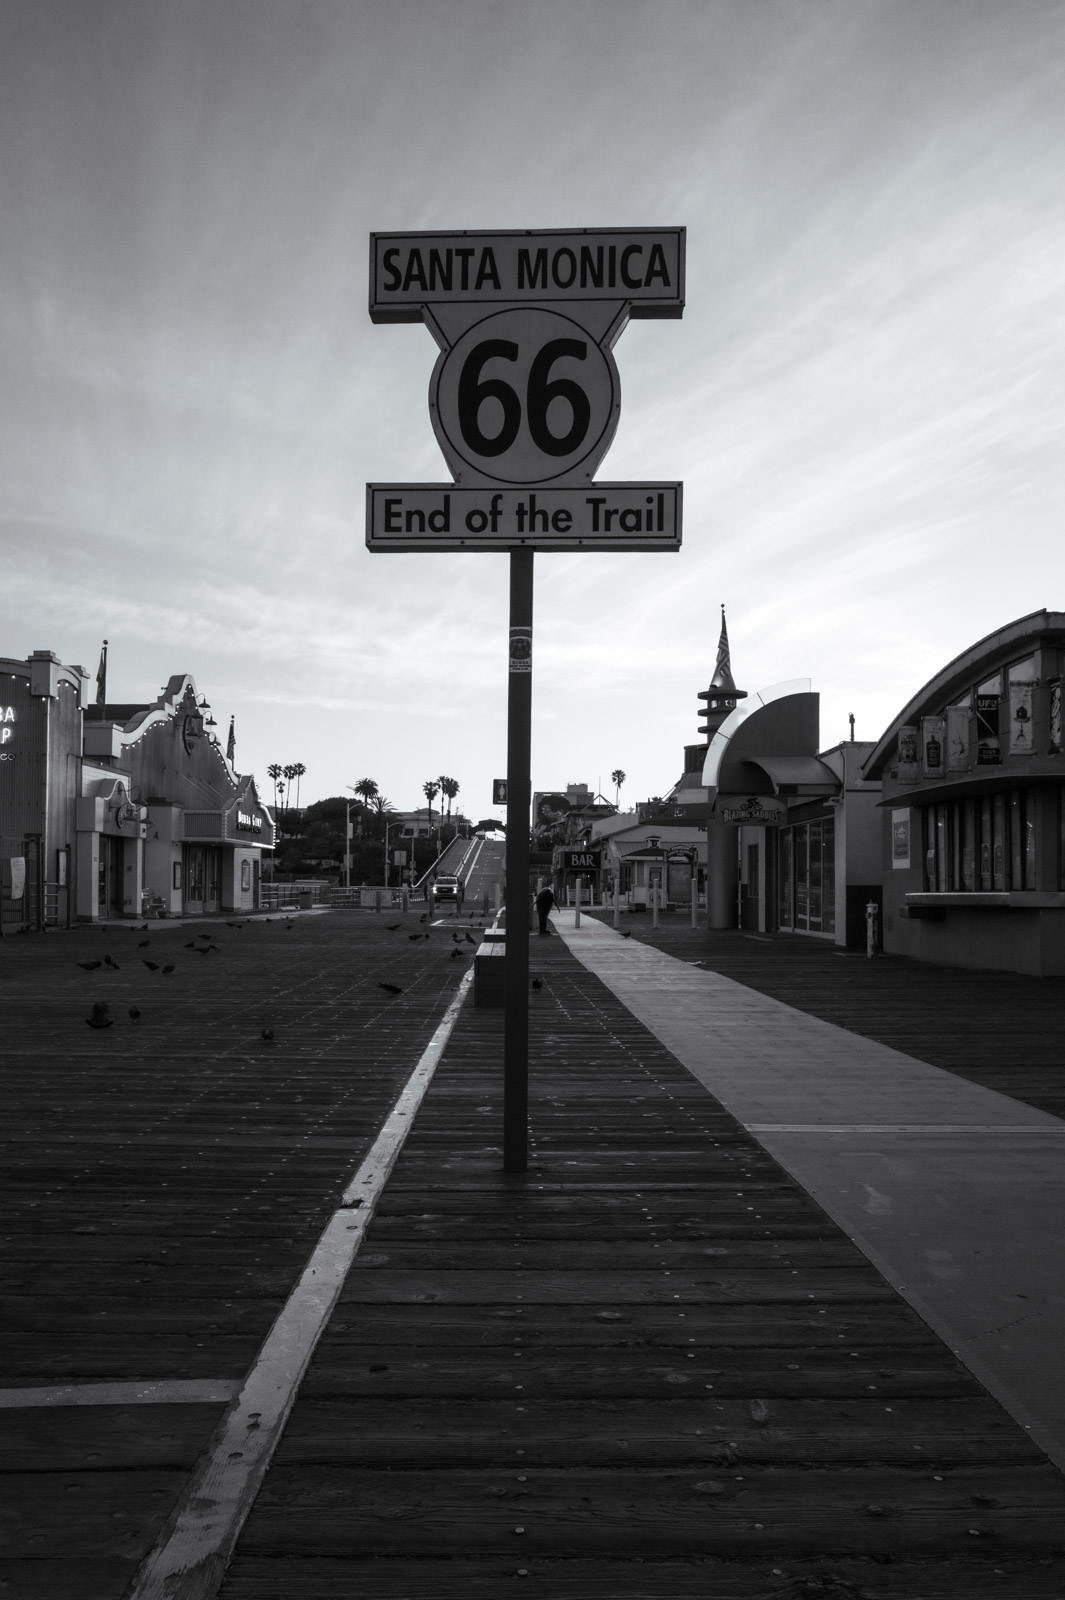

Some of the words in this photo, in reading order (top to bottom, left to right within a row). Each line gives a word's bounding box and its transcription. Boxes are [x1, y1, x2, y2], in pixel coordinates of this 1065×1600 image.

[382, 246, 502, 292] SANTA
[516, 243, 671, 291] MONICA
[457, 338, 591, 458] 66
[384, 494, 451, 534] End
[464, 494, 503, 534] of
[516, 494, 573, 533] the
[586, 493, 665, 533] Trail
[978, 699, 998, 707] UFO
[723, 808, 751, 824] BLAZING
[751, 808, 779, 823] SADDLES
[571, 854, 596, 867] BAR
